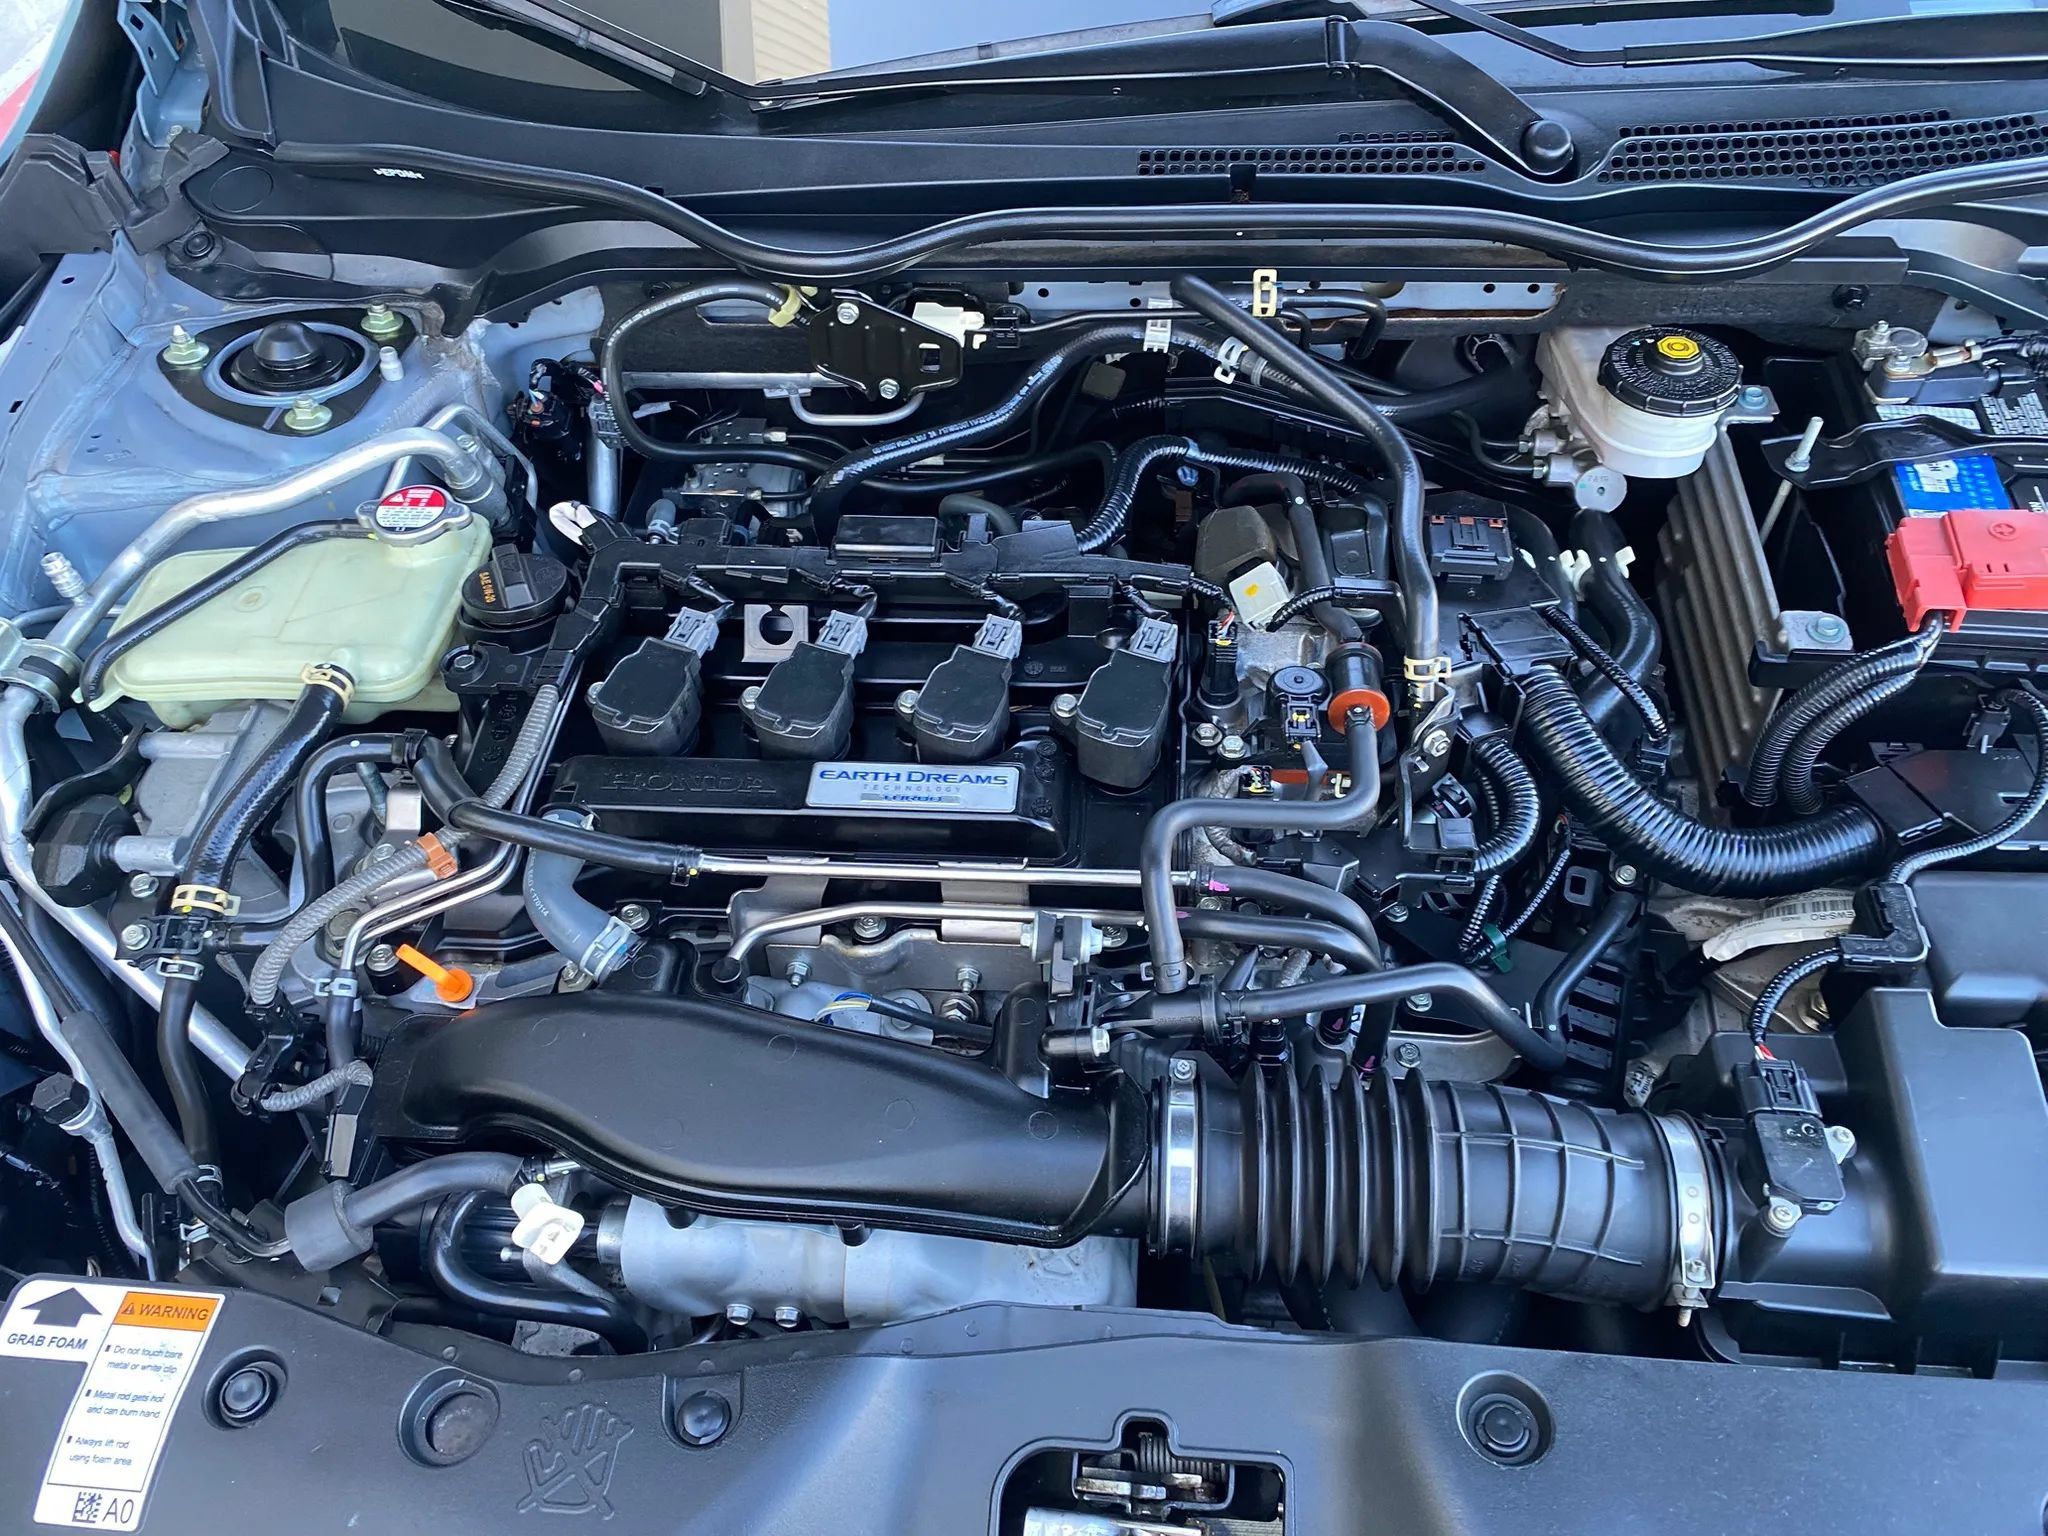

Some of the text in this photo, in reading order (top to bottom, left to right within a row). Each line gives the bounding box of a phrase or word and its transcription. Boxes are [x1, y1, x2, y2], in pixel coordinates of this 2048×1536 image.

[600, 769, 778, 794] HONDA
[819, 769, 1009, 786] EARTH DREAMS
[863, 784, 961, 793] TECHNOLOGY
[139, 1303, 210, 1321] WARNING
[7, 1333, 89, 1350] GRAB FOAM
[113, 1345, 183, 1359] Do not touch bare
[107, 1361, 130, 1370] metal
[141, 1364, 162, 1372] white
[94, 1389, 165, 1403] Metal rod gets hot
[86, 1406, 103, 1414] and
[104, 1407, 118, 1415] can
[75, 1436, 104, 1449] Always
[115, 1440, 131, 1449] rod
[69, 1453, 91, 1465] using
[92, 1454, 113, 1464] foam
[102, 1498, 135, 1524] A0
